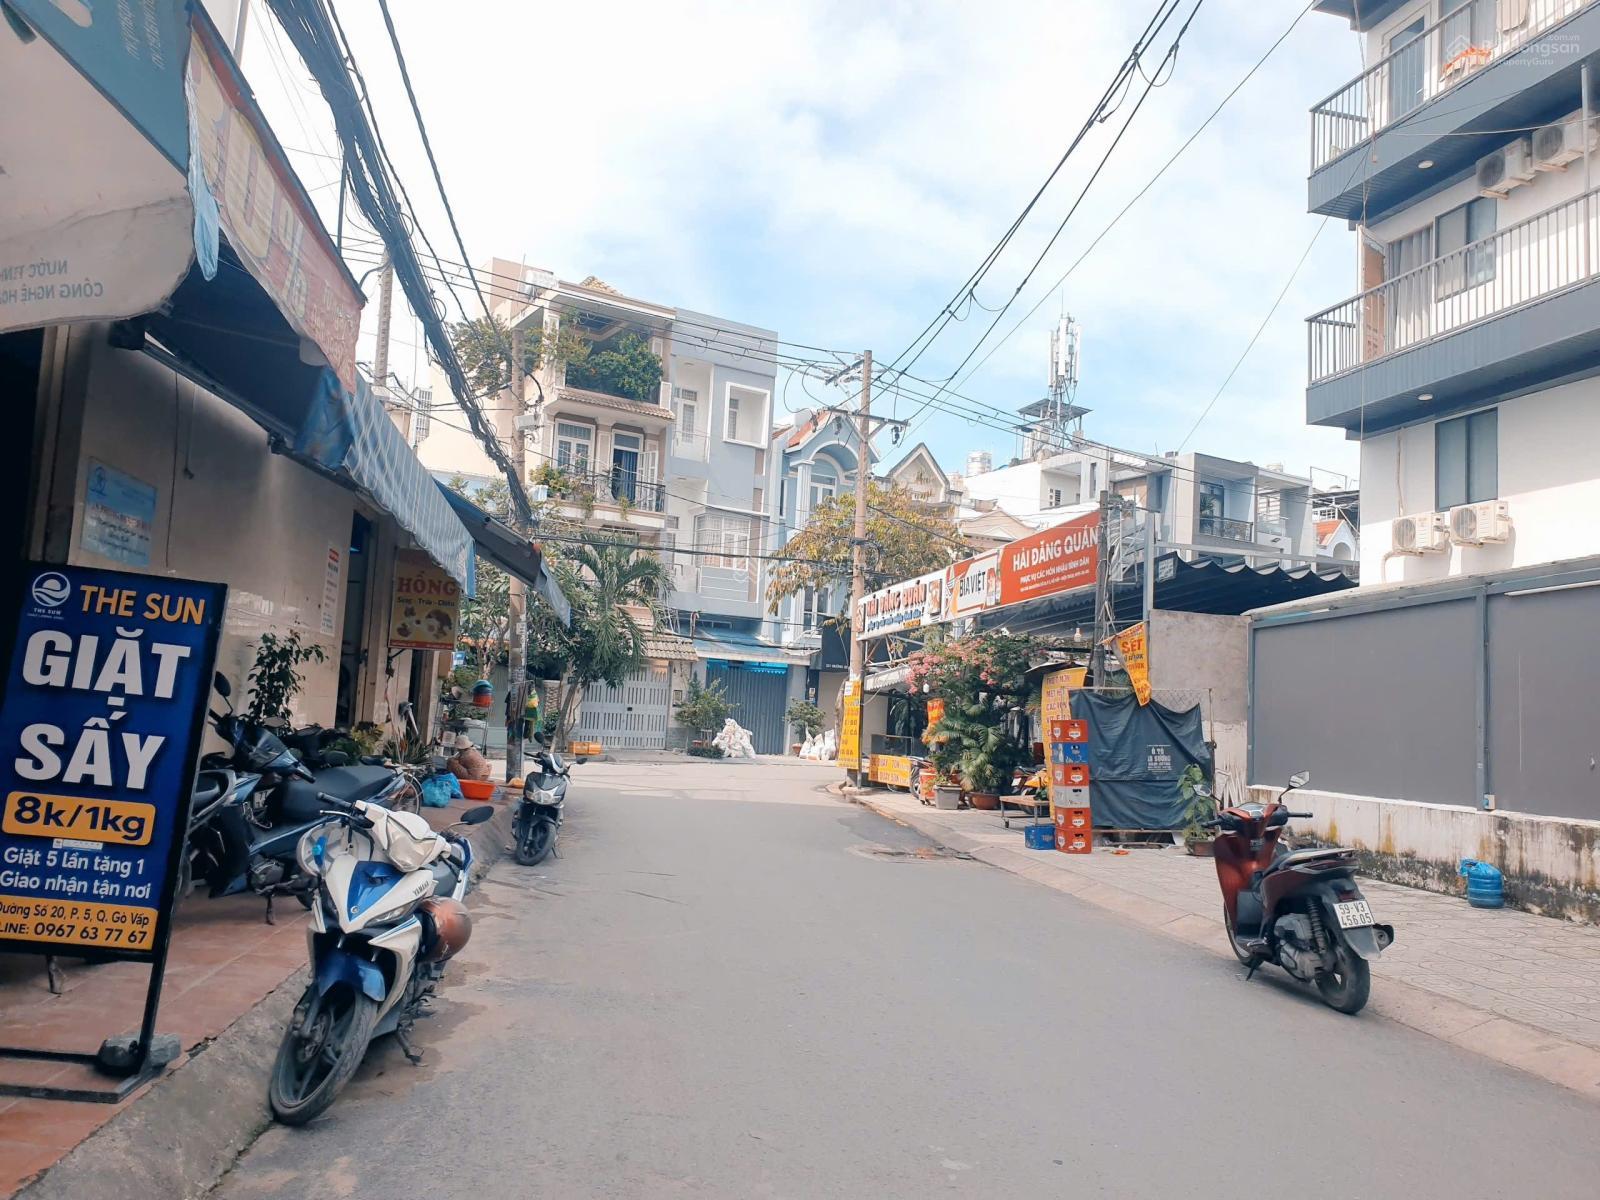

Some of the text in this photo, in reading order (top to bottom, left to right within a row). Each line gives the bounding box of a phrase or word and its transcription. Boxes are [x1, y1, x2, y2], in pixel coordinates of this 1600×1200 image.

[80, 585, 205, 625] THE SUN
[22, 626, 191, 707] GIẶT
[14, 711, 166, 790] SẤY
[14, 795, 146, 841] 8k/1kg
[3, 846, 144, 878] Giặt 5 lần tặng 1
[0, 870, 152, 900] Giao nhận tận nơi
[51, 905, 66, 920] 20,
[70, 907, 80, 920] P.
[96, 909, 108, 923] Q.
[34, 922, 75, 938] 0967
[80, 926, 98, 940] 63
[104, 927, 123, 942] 77
[127, 930, 147, 944] 67
